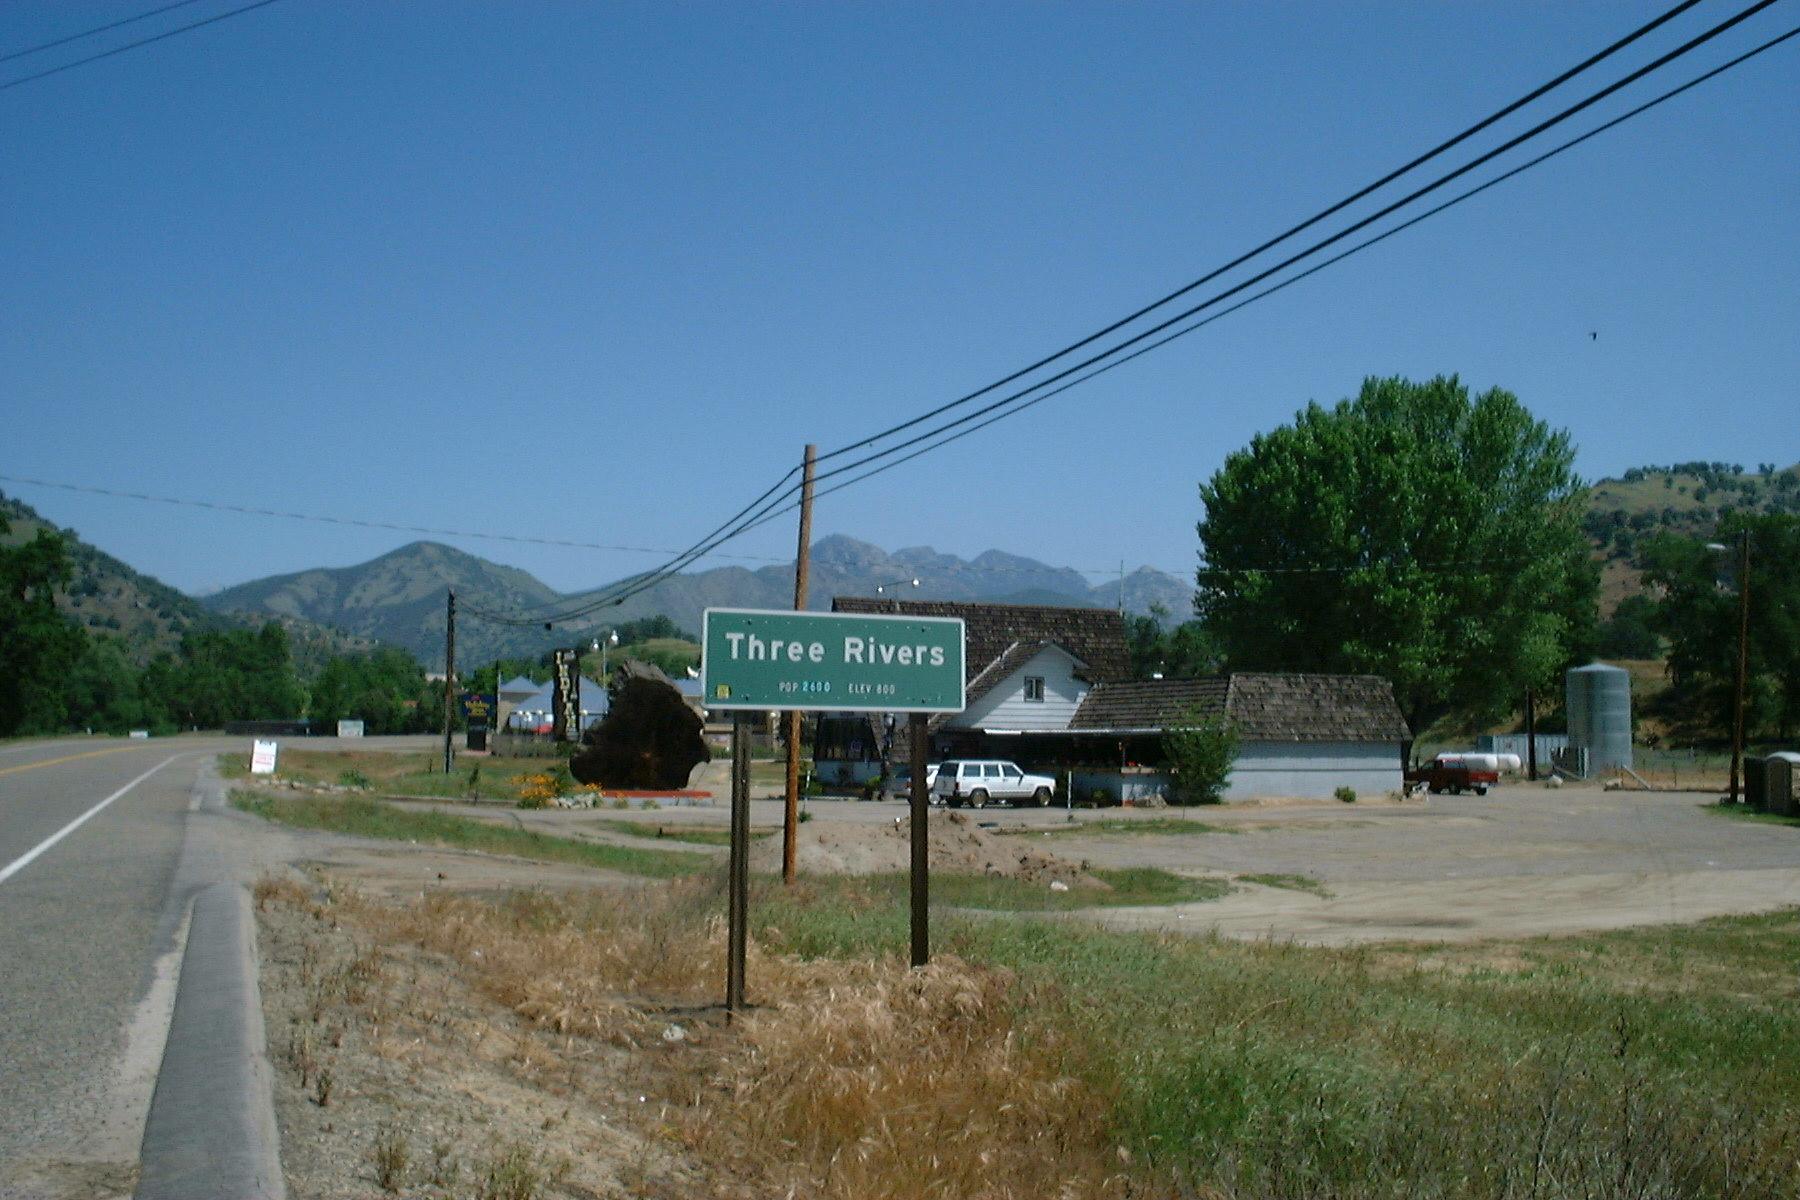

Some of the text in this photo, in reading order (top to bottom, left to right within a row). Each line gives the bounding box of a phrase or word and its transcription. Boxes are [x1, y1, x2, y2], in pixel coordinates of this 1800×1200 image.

[725, 632, 944, 666] Three Rivers
[778, 682, 799, 692] POP
[848, 683, 872, 694] ELEV
